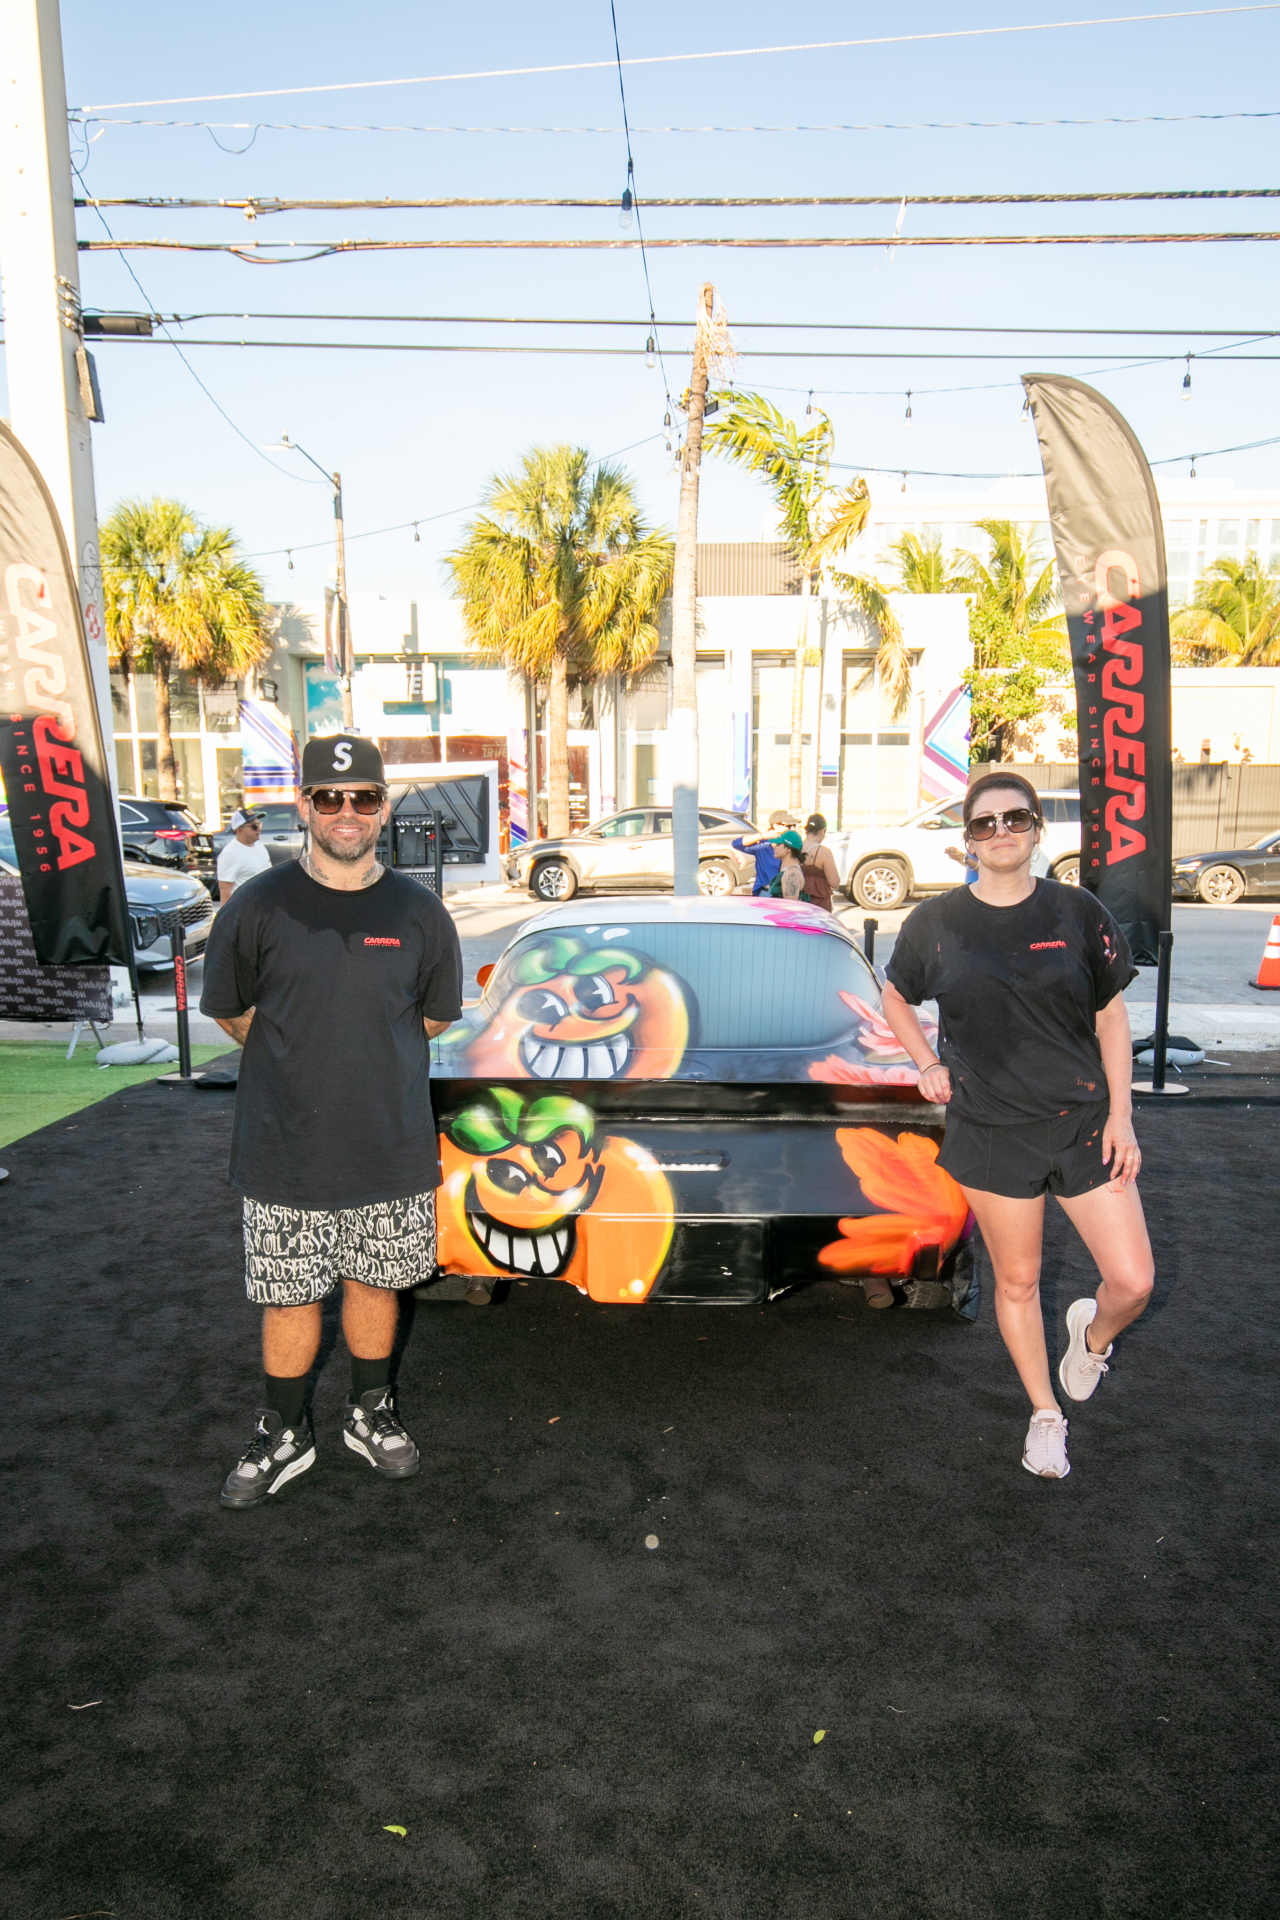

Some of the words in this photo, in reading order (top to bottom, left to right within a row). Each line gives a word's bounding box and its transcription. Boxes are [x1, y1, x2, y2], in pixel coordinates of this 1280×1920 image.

[1074, 555, 1097, 683] EYEWEAR
[4, 562, 96, 871] CARRERA
[1094, 549, 1147, 867] CARRERA
[332, 741, 353, 772] S
[1089, 706, 1100, 786] SINCE
[10, 713, 36, 793] SINCE
[30, 814, 51, 873] 1956
[1091, 808, 1100, 868] 1956
[15, 948, 37, 959] SWAR
[363, 936, 402, 946] CARRERA
[1029, 940, 1067, 950] CARRERA
[16, 968, 45, 978] SWARM
[56, 970, 87, 980] SWARM
[36, 978, 65, 989] SWARM
[174, 955, 186, 1012] CARRERA
[16, 986, 45, 996] SWARM
[56, 989, 87, 999] SWARM
[36, 996, 65, 1007] SWARM
[77, 1000, 109, 1011] SWARM
